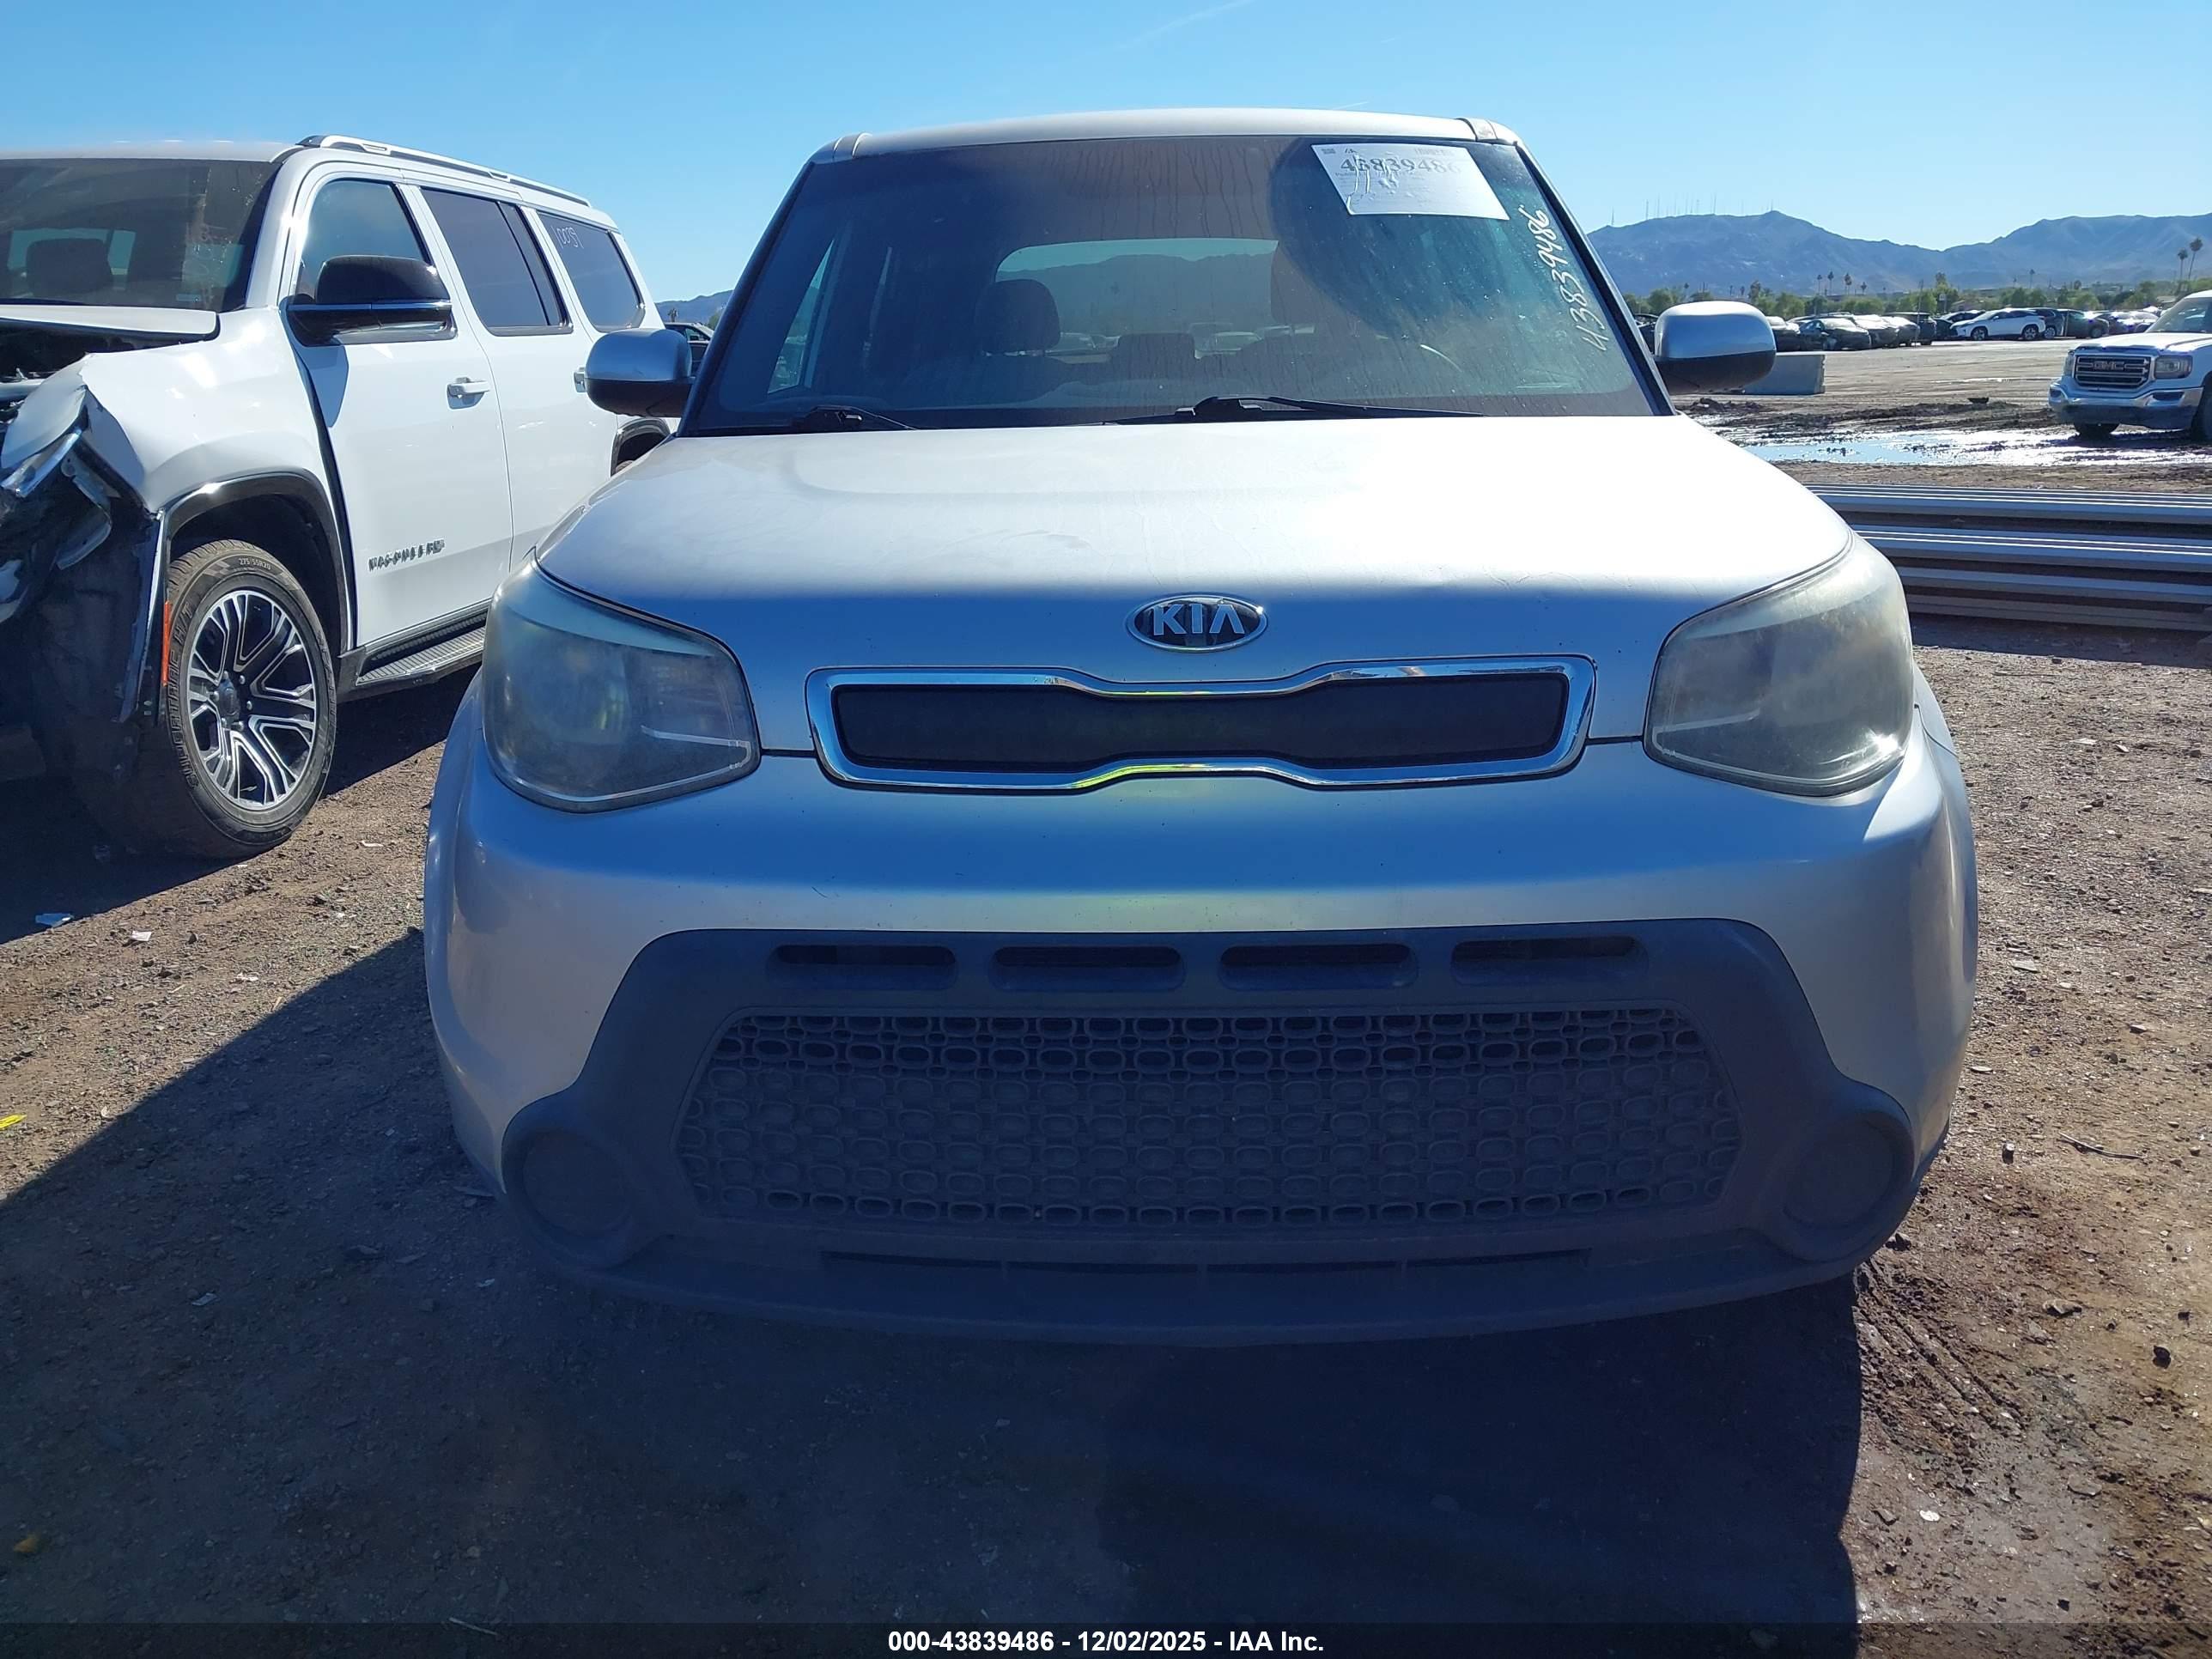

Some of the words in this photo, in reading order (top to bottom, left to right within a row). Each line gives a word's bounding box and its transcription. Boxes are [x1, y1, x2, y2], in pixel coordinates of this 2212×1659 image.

[1518, 204, 1610, 351] 43839486
[2094, 361, 2125, 371] GMC
[1153, 604, 1245, 636] KIA
